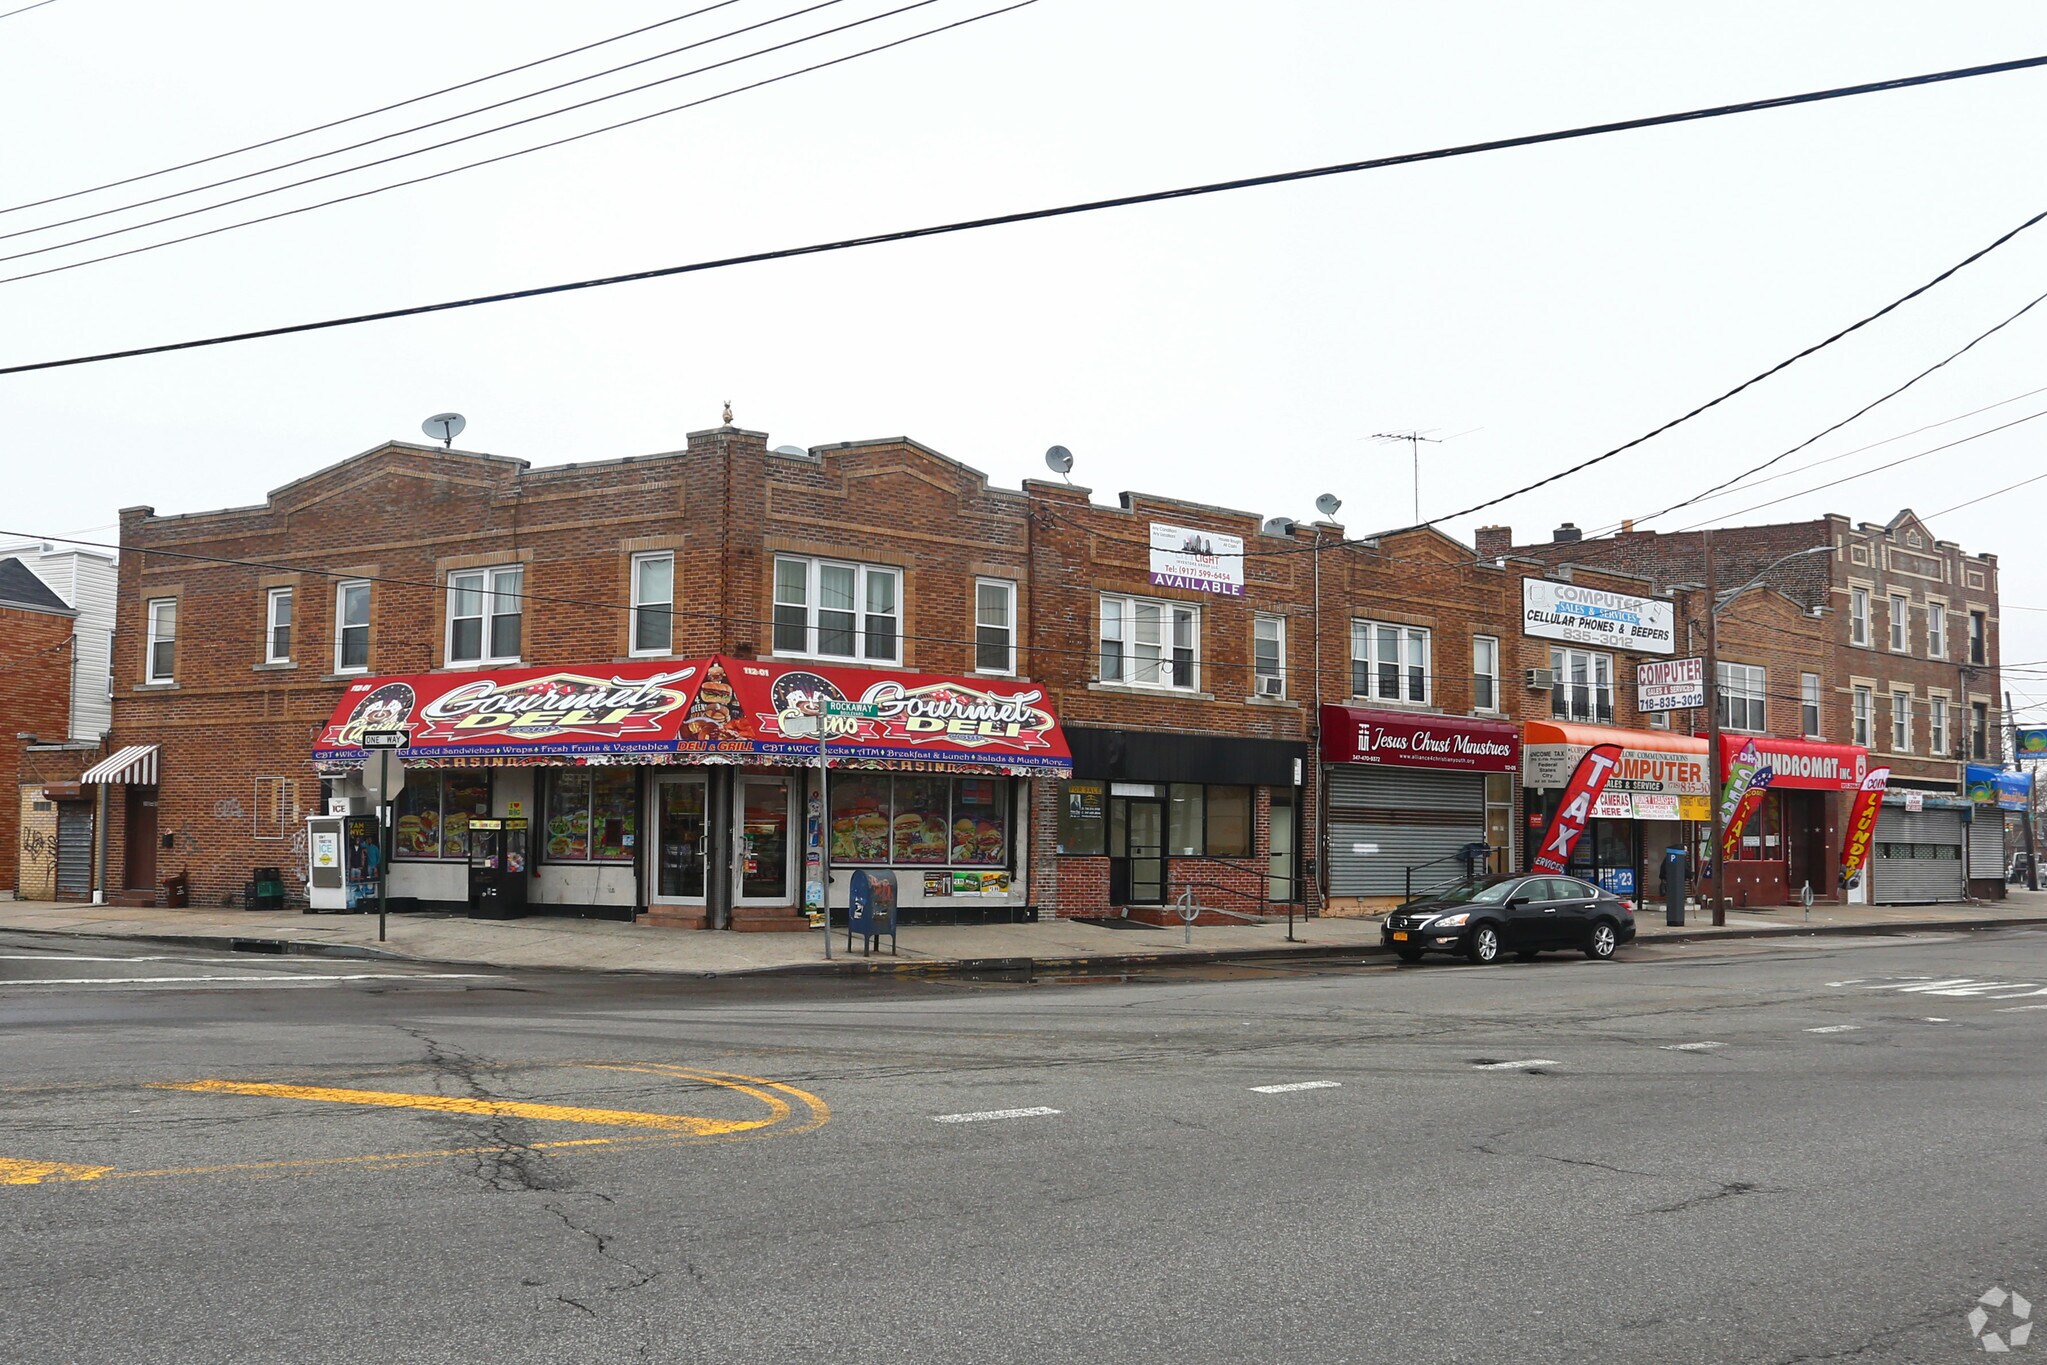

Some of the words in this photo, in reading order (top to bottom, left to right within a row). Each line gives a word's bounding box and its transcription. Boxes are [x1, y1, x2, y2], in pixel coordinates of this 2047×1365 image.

[1195, 554, 1220, 565] LIGHT
[1165, 565, 1177, 573] Tel:
[1179, 566, 1196, 576] (917)
[1198, 570, 1230, 580] 599-6454
[1154, 574, 1240, 596] AVAILABLE
[1554, 585, 1643, 613] COMPUTER
[1560, 602, 1585, 615] SALES
[1588, 607, 1595, 616] &
[1600, 608, 1637, 623] SERVICES
[1527, 610, 1575, 627] CELLULAR
[1578, 618, 1614, 632] PHONES
[1618, 624, 1625, 634] &
[1631, 626, 1670, 641] BEEPERS
[1562, 628, 1634, 648] 835-3012
[743, 667, 770, 676] 112-01
[1639, 660, 1701, 686] COMPUTER
[427, 666, 696, 718] Gourmet
[830, 702, 873, 712] ROCKAWAY
[861, 681, 1041, 722] Gourmet
[1640, 694, 1702, 710] 718-835-3012
[453, 708, 635, 729] DELI
[778, 708, 858, 737] Cino
[906, 717, 1021, 738] DELI
[366, 736, 380, 744] ONE
[387, 736, 400, 744] WAY
[677, 741, 706, 751] DELI
[718, 741, 754, 752] GRILL
[1371, 728, 1408, 750] Jesus
[1411, 731, 1450, 753] Christ
[1453, 734, 1511, 757] Ministries
[340, 750, 356, 758] WIC
[357, 750, 373, 758] Che
[420, 746, 440, 755] Cold
[442, 744, 496, 755] Sandwiches
[502, 746, 534, 754] Wraps
[541, 745, 568, 753] Fresh
[571, 744, 600, 752] Fruits
[602, 744, 611, 752] &
[613, 743, 670, 752] Vegetables
[793, 744, 813, 753] WIC
[857, 748, 880, 756] ATM
[887, 749, 932, 759] Breakfast
[933, 751, 940, 759] &
[942, 752, 970, 760] Lunch
[976, 754, 1006, 762] Salads
[1016, 756, 1040, 764] Much
[1042, 758, 1070, 767] More...
[440, 758, 517, 766] CASINO
[1638, 752, 1689, 761] COMMUNICATIONS
[1740, 752, 1756, 764] DR
[887, 760, 957, 771] CASINO
[1612, 758, 1702, 782] OMPUTER
[1755, 751, 1839, 778] AUNDROMAT
[1840, 768, 1852, 780] INC.
[1633, 782, 1660, 791] SERVICE
[1680, 782, 1710, 794] 835-30
[1867, 778, 1887, 790] COIN
[1546, 752, 1614, 858] TAX
[1600, 794, 1630, 806] CAMERAS
[1602, 808, 1622, 816] HERE
[1844, 792, 1877, 880] LAUNDRY
[318, 844, 332, 853] ICE
[1670, 854, 1676, 862] P
